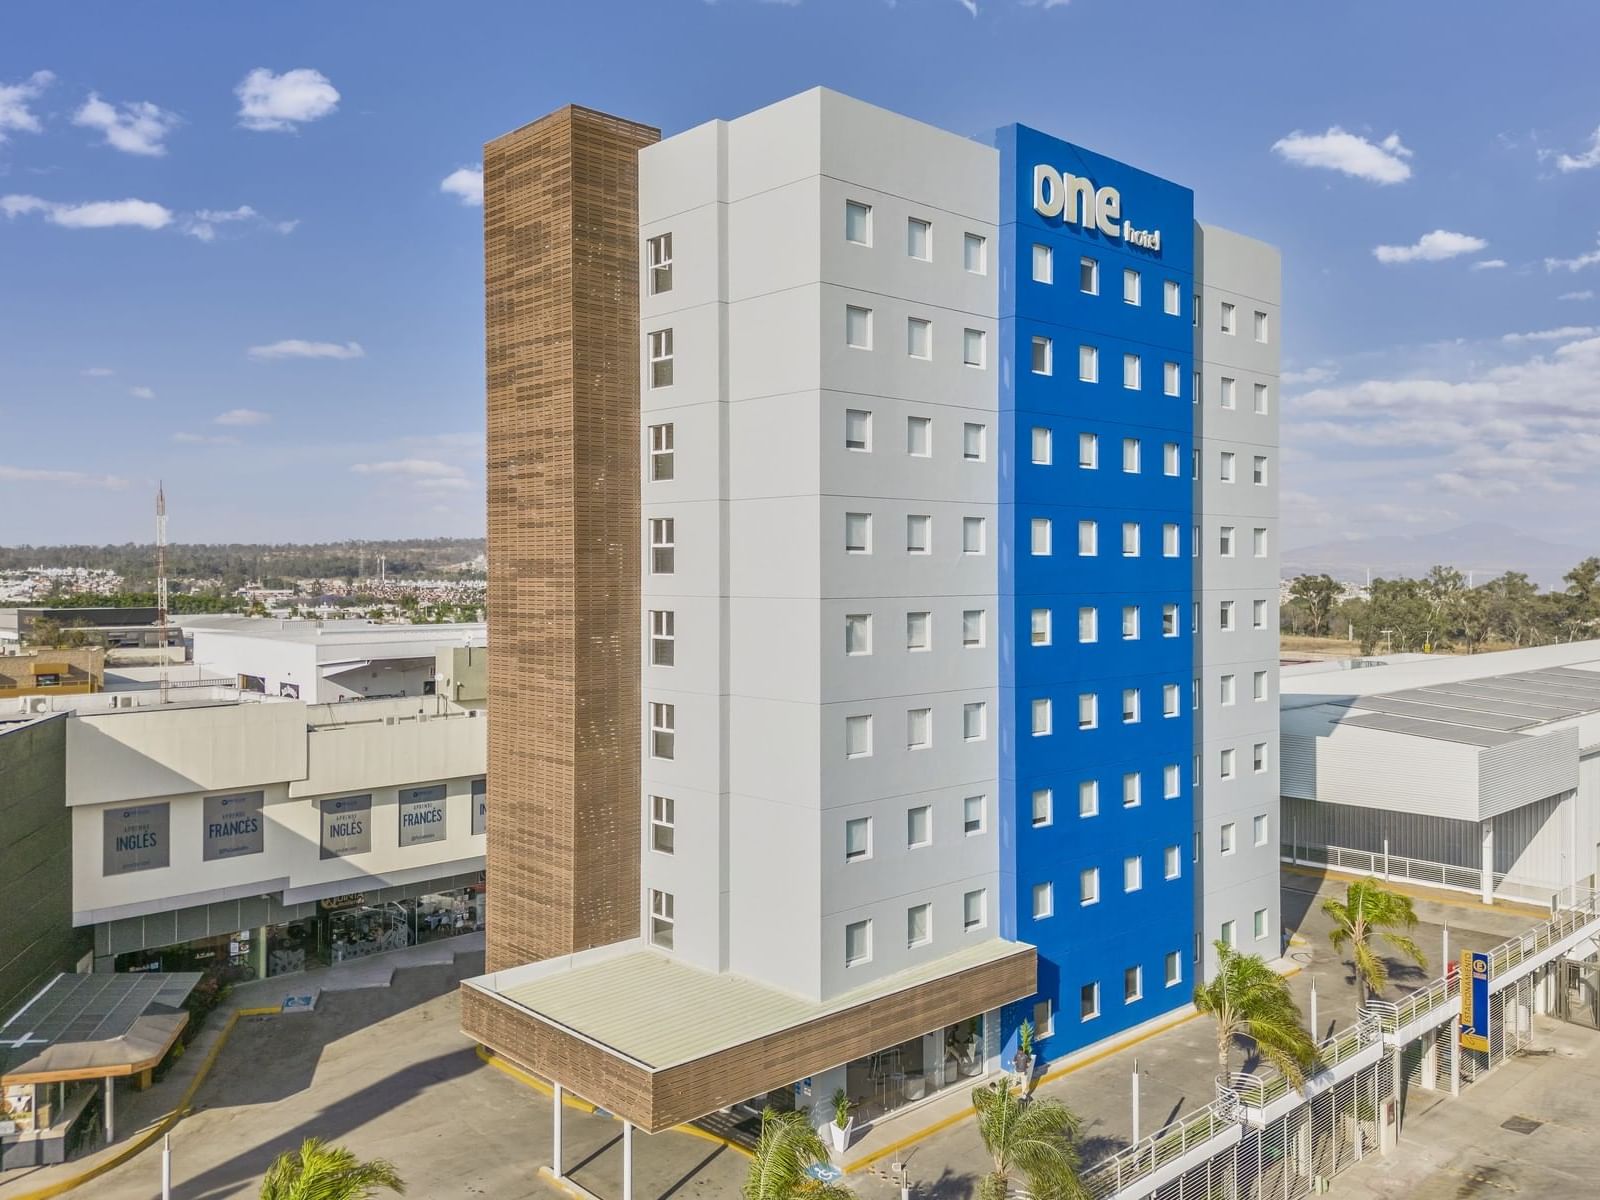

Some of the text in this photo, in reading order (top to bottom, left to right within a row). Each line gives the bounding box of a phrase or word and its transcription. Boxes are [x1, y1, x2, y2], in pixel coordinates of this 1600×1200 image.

[1123, 219, 1161, 251] hotel
[208, 817, 259, 839] FRANCÉS
[330, 817, 363, 838] INGLÉS
[403, 807, 443, 827] FRANCÉS
[116, 829, 157, 852] INGLÉS
[1464, 952, 1472, 1024] ESTACIONAMIENTO
